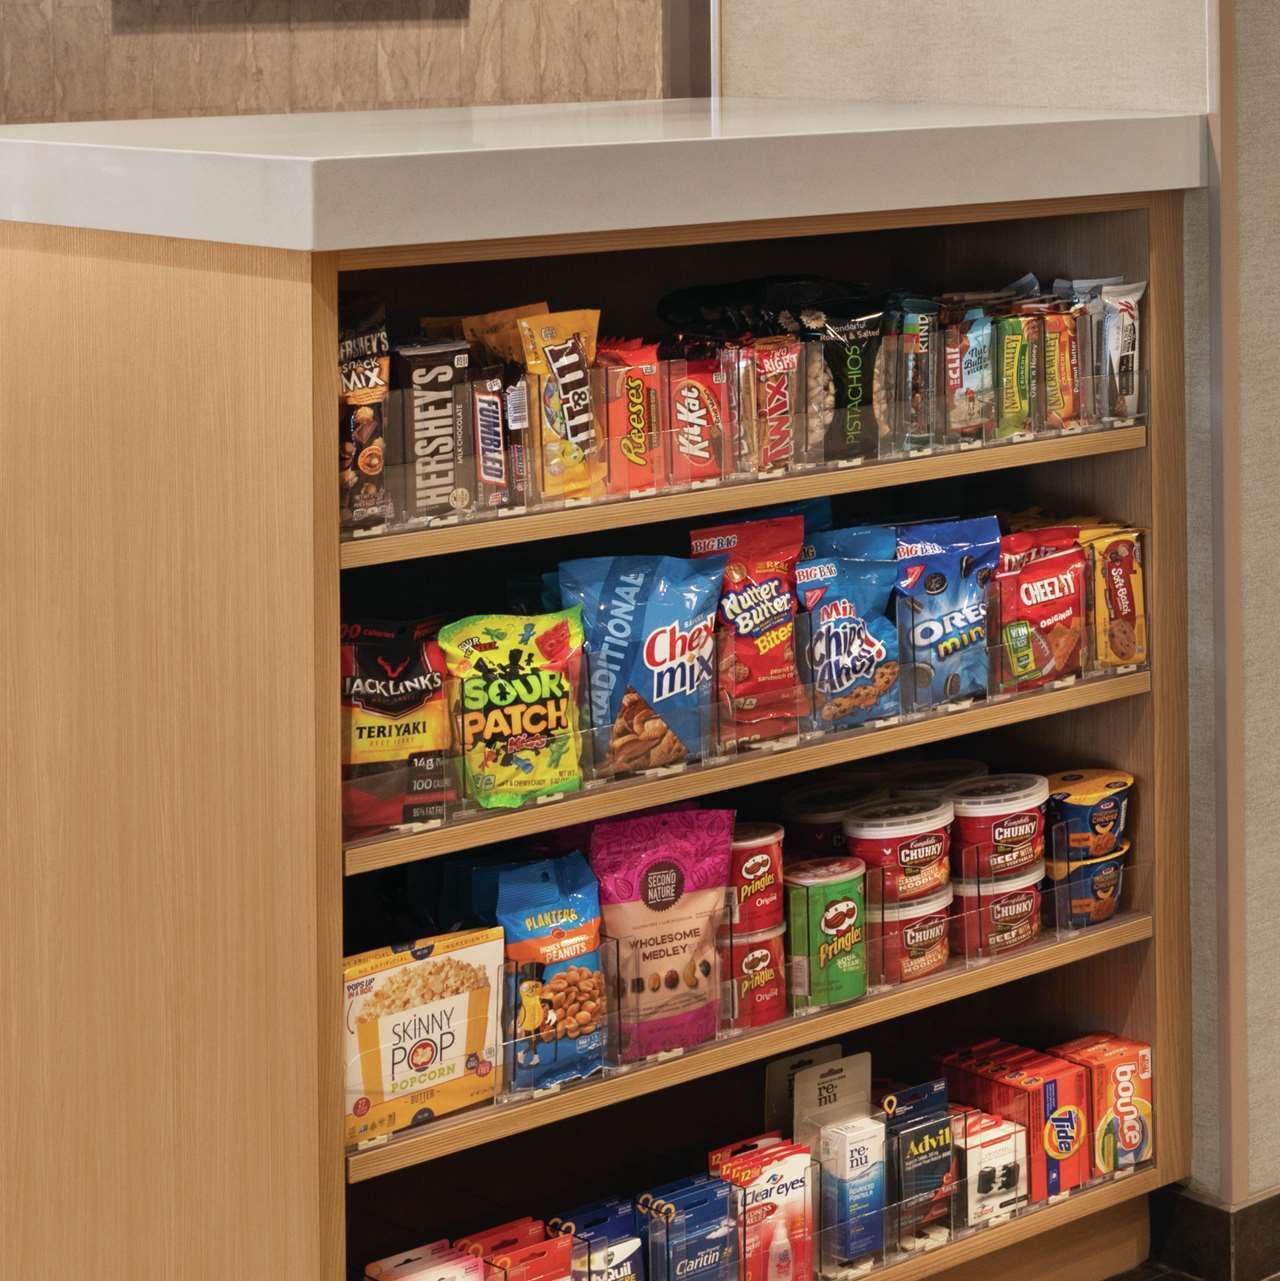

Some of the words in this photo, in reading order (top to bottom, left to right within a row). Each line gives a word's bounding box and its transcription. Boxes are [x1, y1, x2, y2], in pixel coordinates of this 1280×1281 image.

[340, 331, 389, 360] ERSHEY'S
[919, 314, 929, 353] KIND
[763, 352, 798, 372] RIGHT
[845, 345, 863, 445] PISTACHIOS
[762, 373, 794, 468] TWIX
[412, 364, 454, 508] HERSHEY'S
[478, 397, 503, 479] FUMBLED
[691, 539, 716, 554] BIG
[716, 534, 737, 550] BAG
[796, 569, 817, 584] BIG
[721, 579, 780, 620] Nutter
[735, 593, 791, 634] Butter
[645, 613, 715, 668] Chex
[754, 622, 793, 655] Bites
[464, 671, 563, 710] SOUR
[356, 721, 428, 739] TERIYAKI
[464, 697, 568, 746] PATCH
[412, 778, 433, 791] 100
[994, 820, 1036, 841] CHUNKY
[900, 841, 943, 863] CHUNKY
[990, 850, 1019, 866] BEEF
[647, 871, 677, 888] SECOND
[648, 884, 676, 903] NATURE
[740, 873, 775, 903] Pringles
[993, 899, 1033, 920] CHUNKY
[629, 927, 701, 953] WHOLESOME
[819, 926, 861, 968] Pringles
[906, 920, 944, 945] CHUNKY
[545, 941, 587, 963] PEANUTS
[641, 943, 689, 963] MEDLEY
[740, 968, 775, 998] Pringles
[391, 1031, 456, 1082] POP
[391, 1063, 456, 1094] POPCORN
[906, 1126, 952, 1159] Advil
[1050, 1110, 1075, 1153] Tide
[741, 1185, 775, 1207] Clear
[776, 1176, 806, 1197] eyes
[675, 1249, 720, 1276] Claritin
